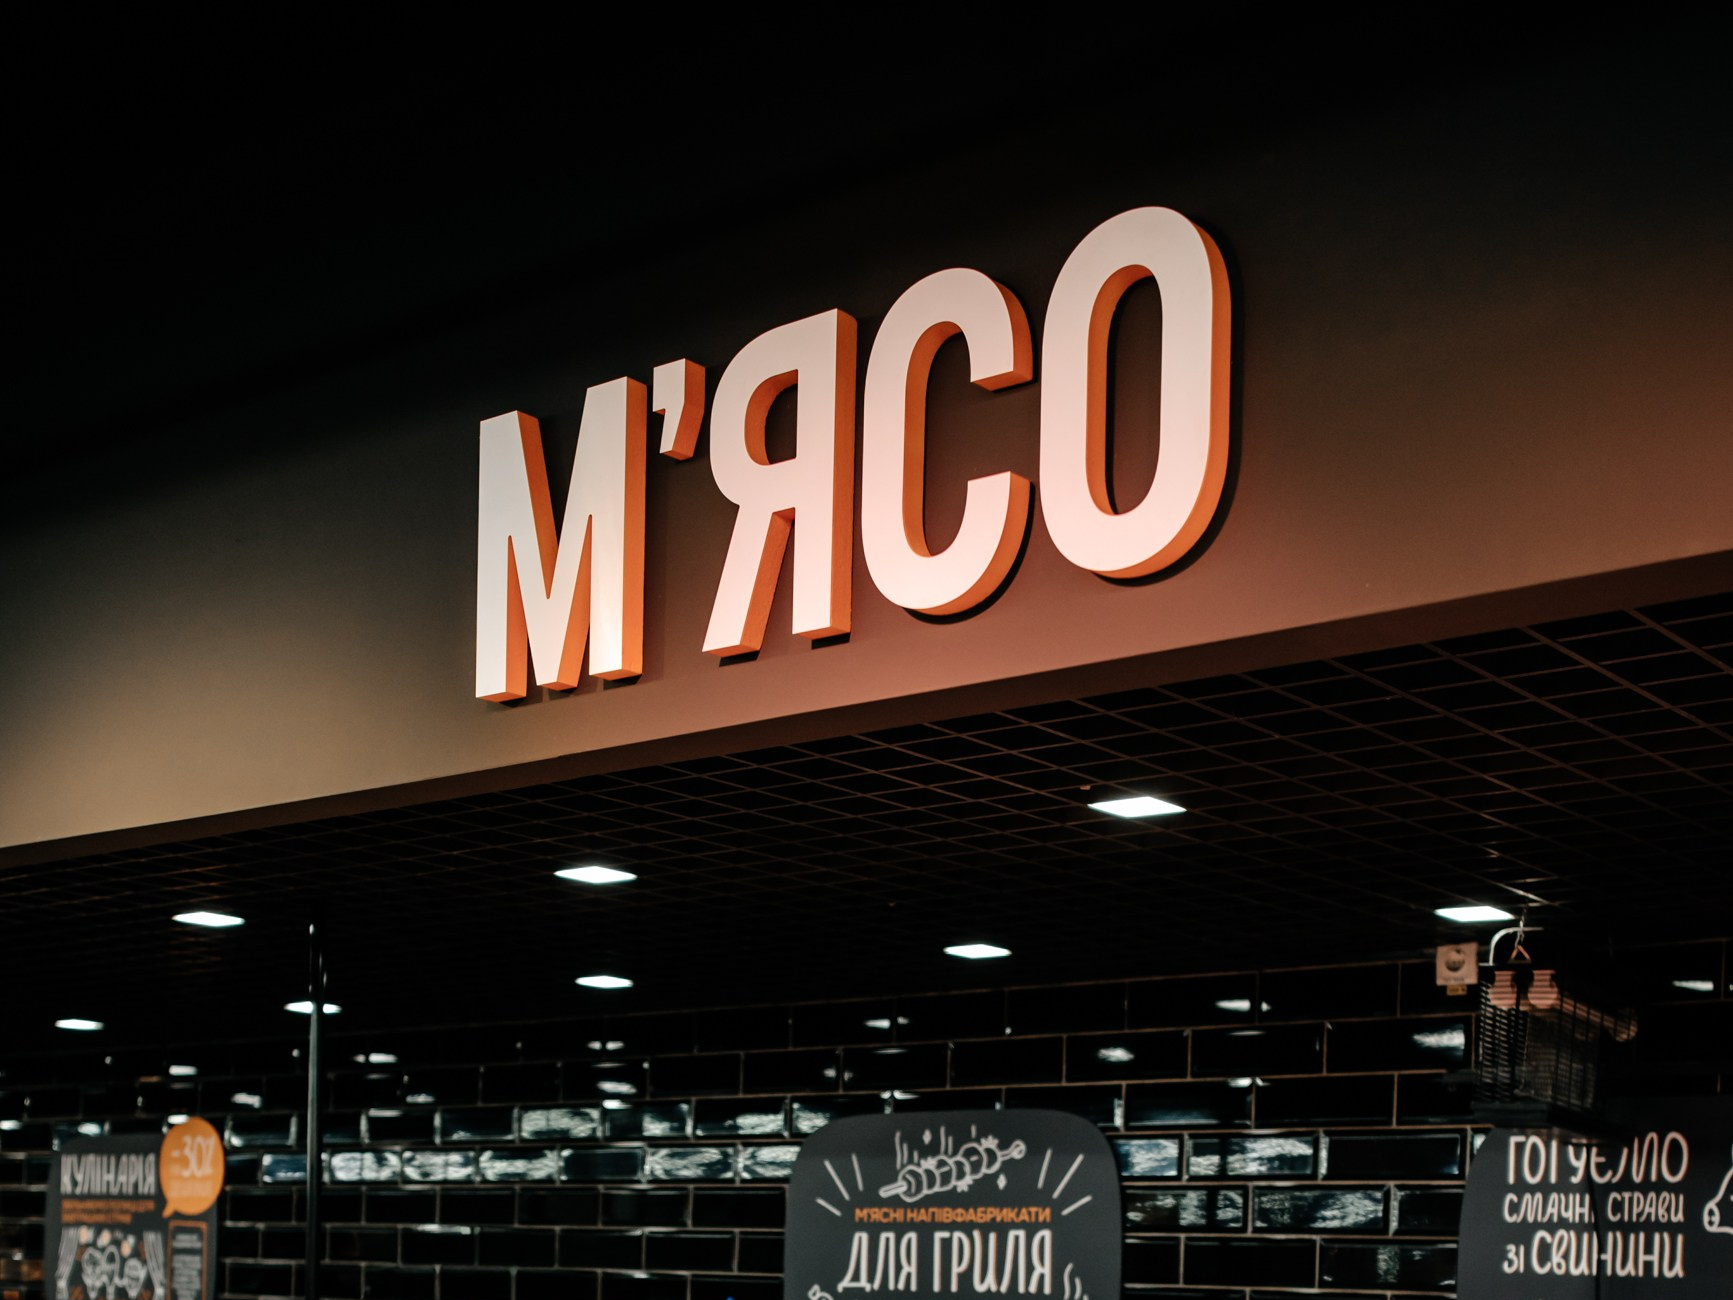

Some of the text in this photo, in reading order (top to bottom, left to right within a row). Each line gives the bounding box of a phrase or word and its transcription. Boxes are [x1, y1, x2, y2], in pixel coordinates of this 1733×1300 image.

[476, 206, 1231, 703] М'ЯСО
[60, 1153, 156, 1196] КУЛІНАРІЯ
[855, 1206, 1051, 1223] М'ЯСНІ НАПІВФАБРИКАТИ
[1607, 1190, 1685, 1223] СТРАВИ
[837, 1229, 1053, 1295] ДЛЯ ГРИЛЯ
[1531, 1229, 1685, 1278] СВИНИНИ
